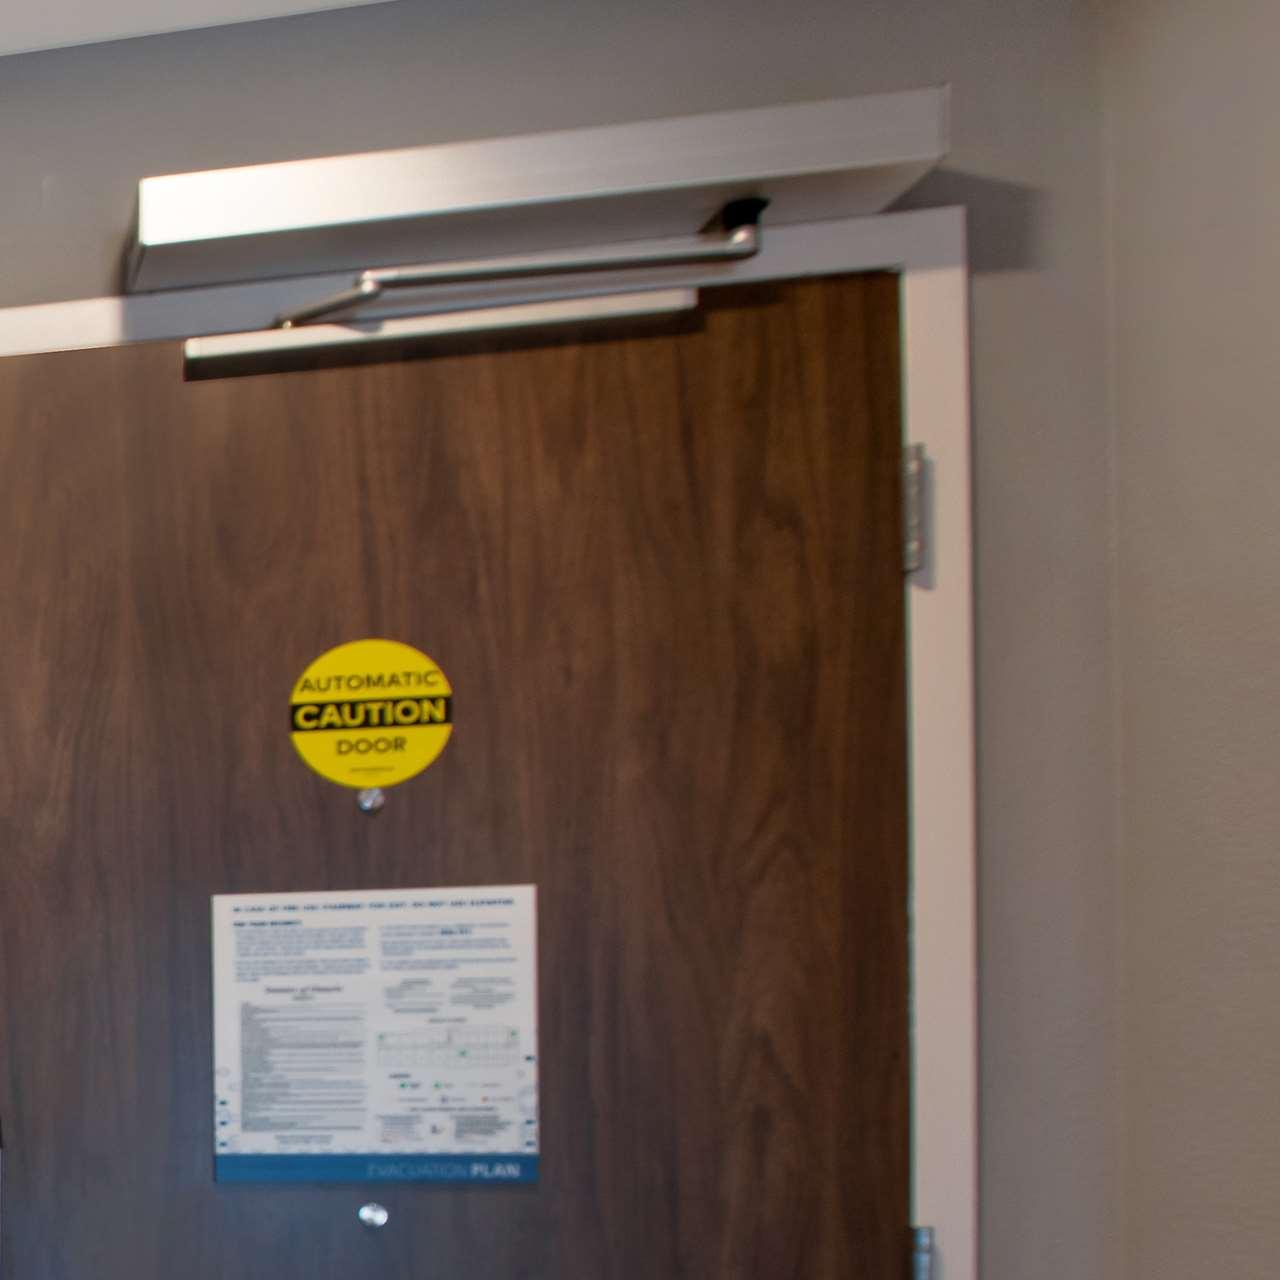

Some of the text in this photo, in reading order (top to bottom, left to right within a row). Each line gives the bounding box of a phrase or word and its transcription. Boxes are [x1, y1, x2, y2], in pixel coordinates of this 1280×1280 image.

[300, 671, 440, 693] AUTOMATIC
[294, 698, 446, 730] CAUTION
[336, 736, 407, 756] DOOR
[367, 1162, 521, 1179] EVACUATION PLAN
